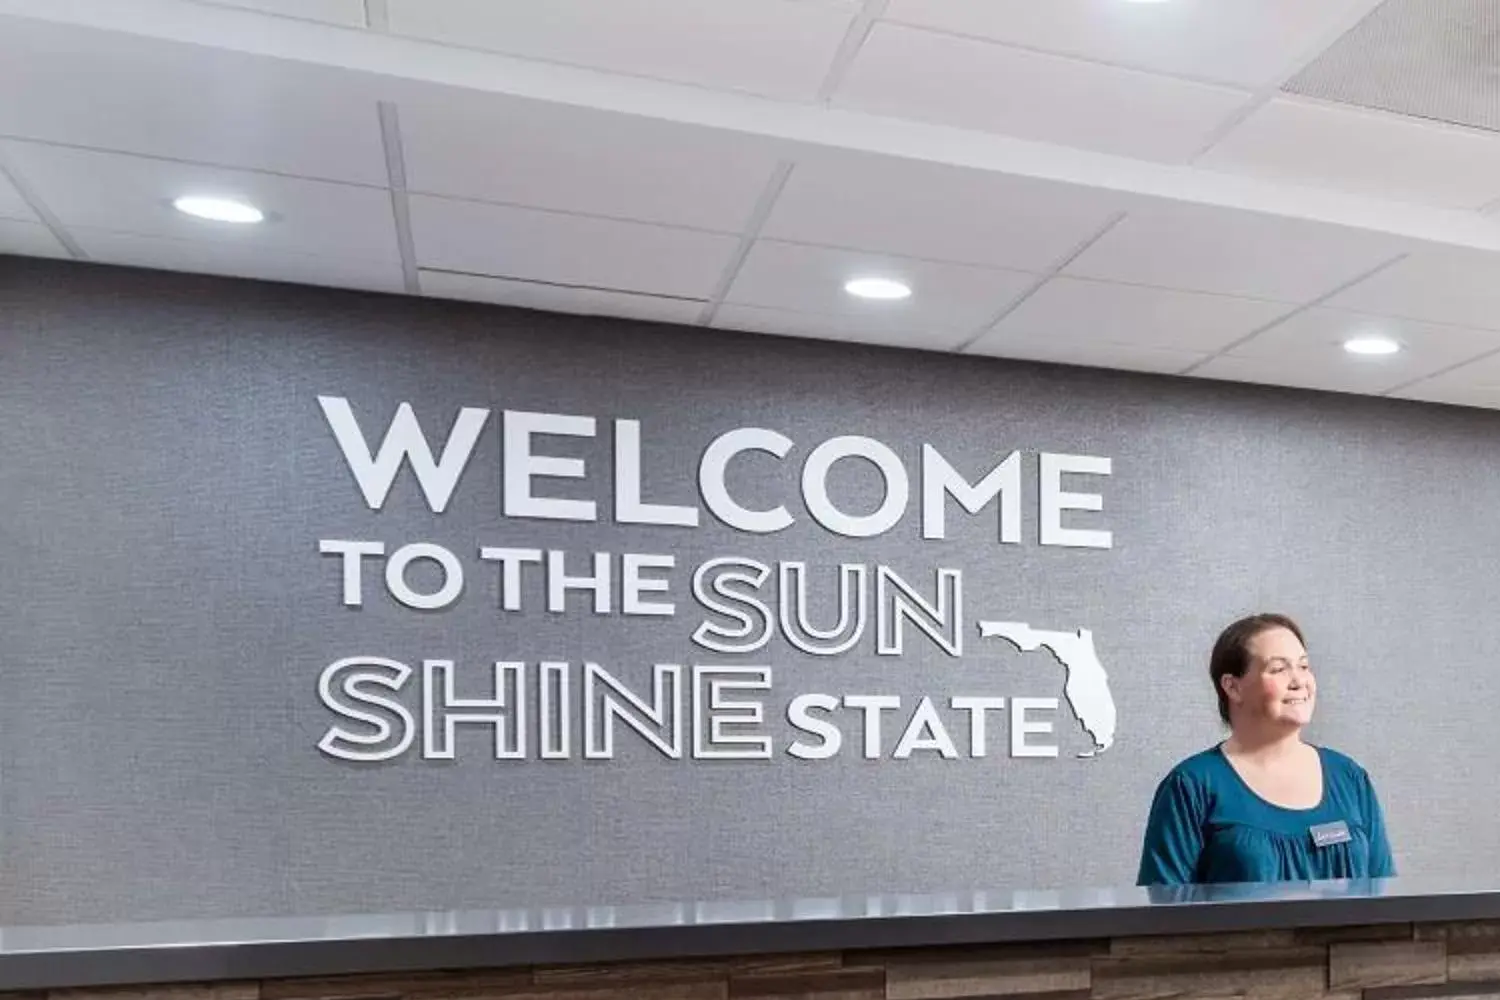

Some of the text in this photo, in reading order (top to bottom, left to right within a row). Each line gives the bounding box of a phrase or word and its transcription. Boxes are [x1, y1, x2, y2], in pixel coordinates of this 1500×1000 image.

[317, 395, 1113, 549] WELCOME
[318, 540, 963, 658] TO THE SUN
[316, 656, 1059, 762] SHINE STATE
